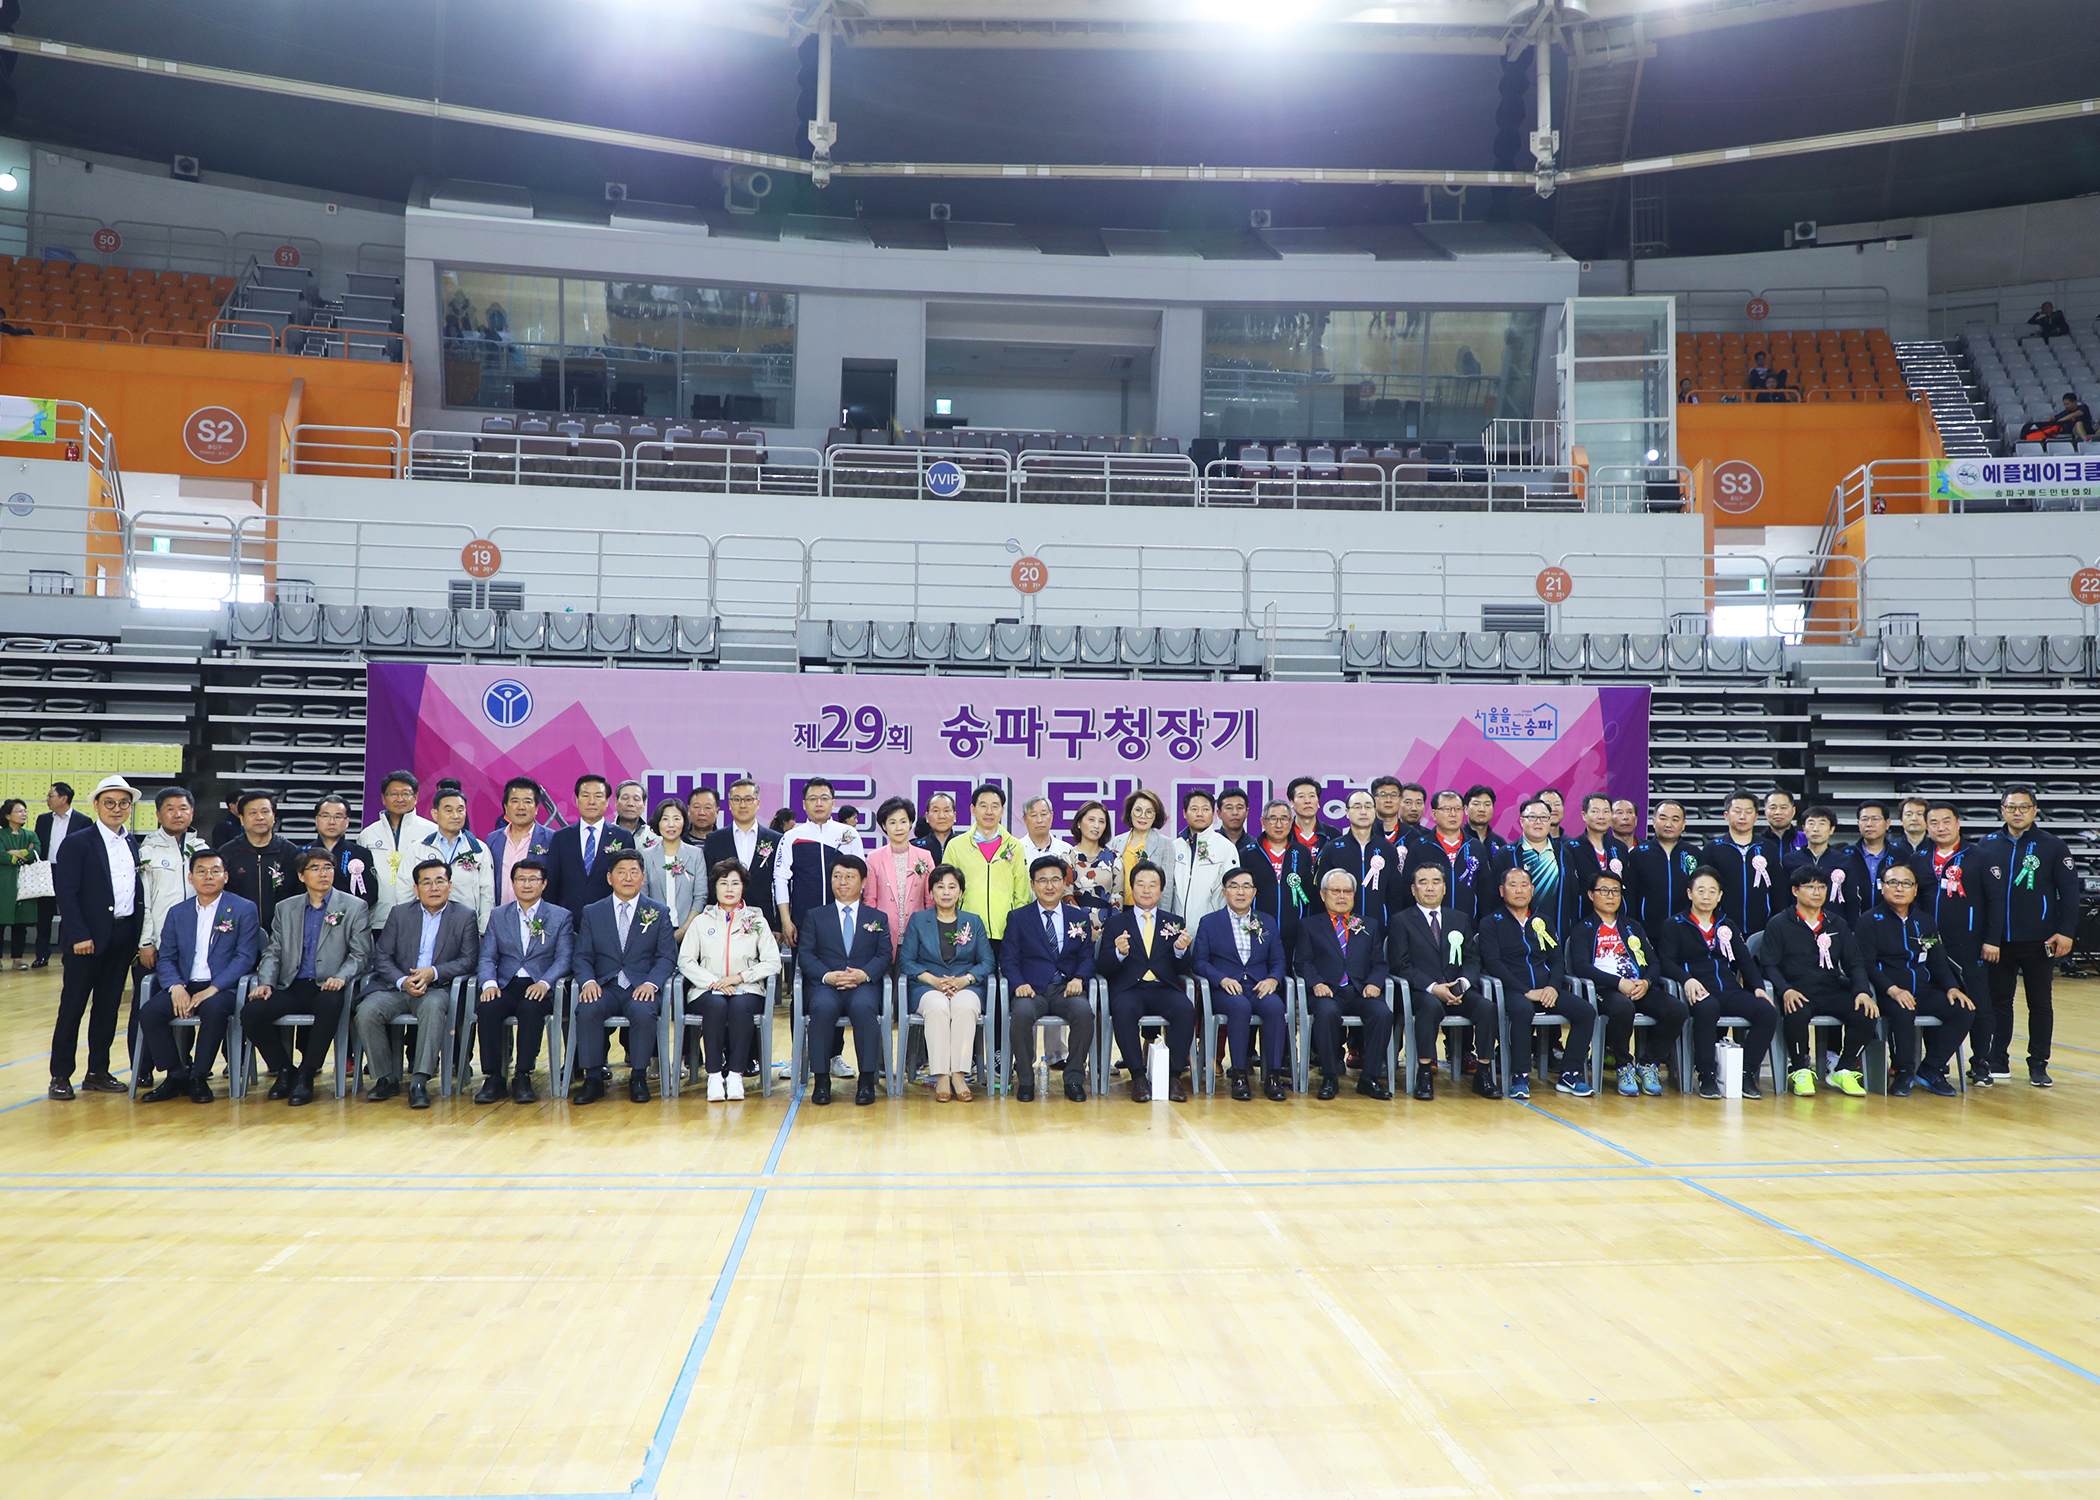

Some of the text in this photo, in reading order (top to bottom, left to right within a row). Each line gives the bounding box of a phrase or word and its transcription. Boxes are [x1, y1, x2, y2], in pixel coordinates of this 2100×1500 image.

[100, 235, 115, 245] 50
[281, 252, 293, 262] 51
[1751, 304, 1764, 313] 23
[197, 419, 234, 443] S2
[928, 473, 960, 485] VVIP
[1720, 473, 1752, 494] S3
[472, 550, 491, 565] 19
[1019, 567, 1040, 581] 20
[1545, 576, 1562, 591] 21
[2080, 578, 2100, 592] 22
[1474, 707, 1511, 723] 서울을
[793, 703, 1258, 761] 제29회 송파구청장기
[1488, 718, 1553, 736] 이끄는 송파
